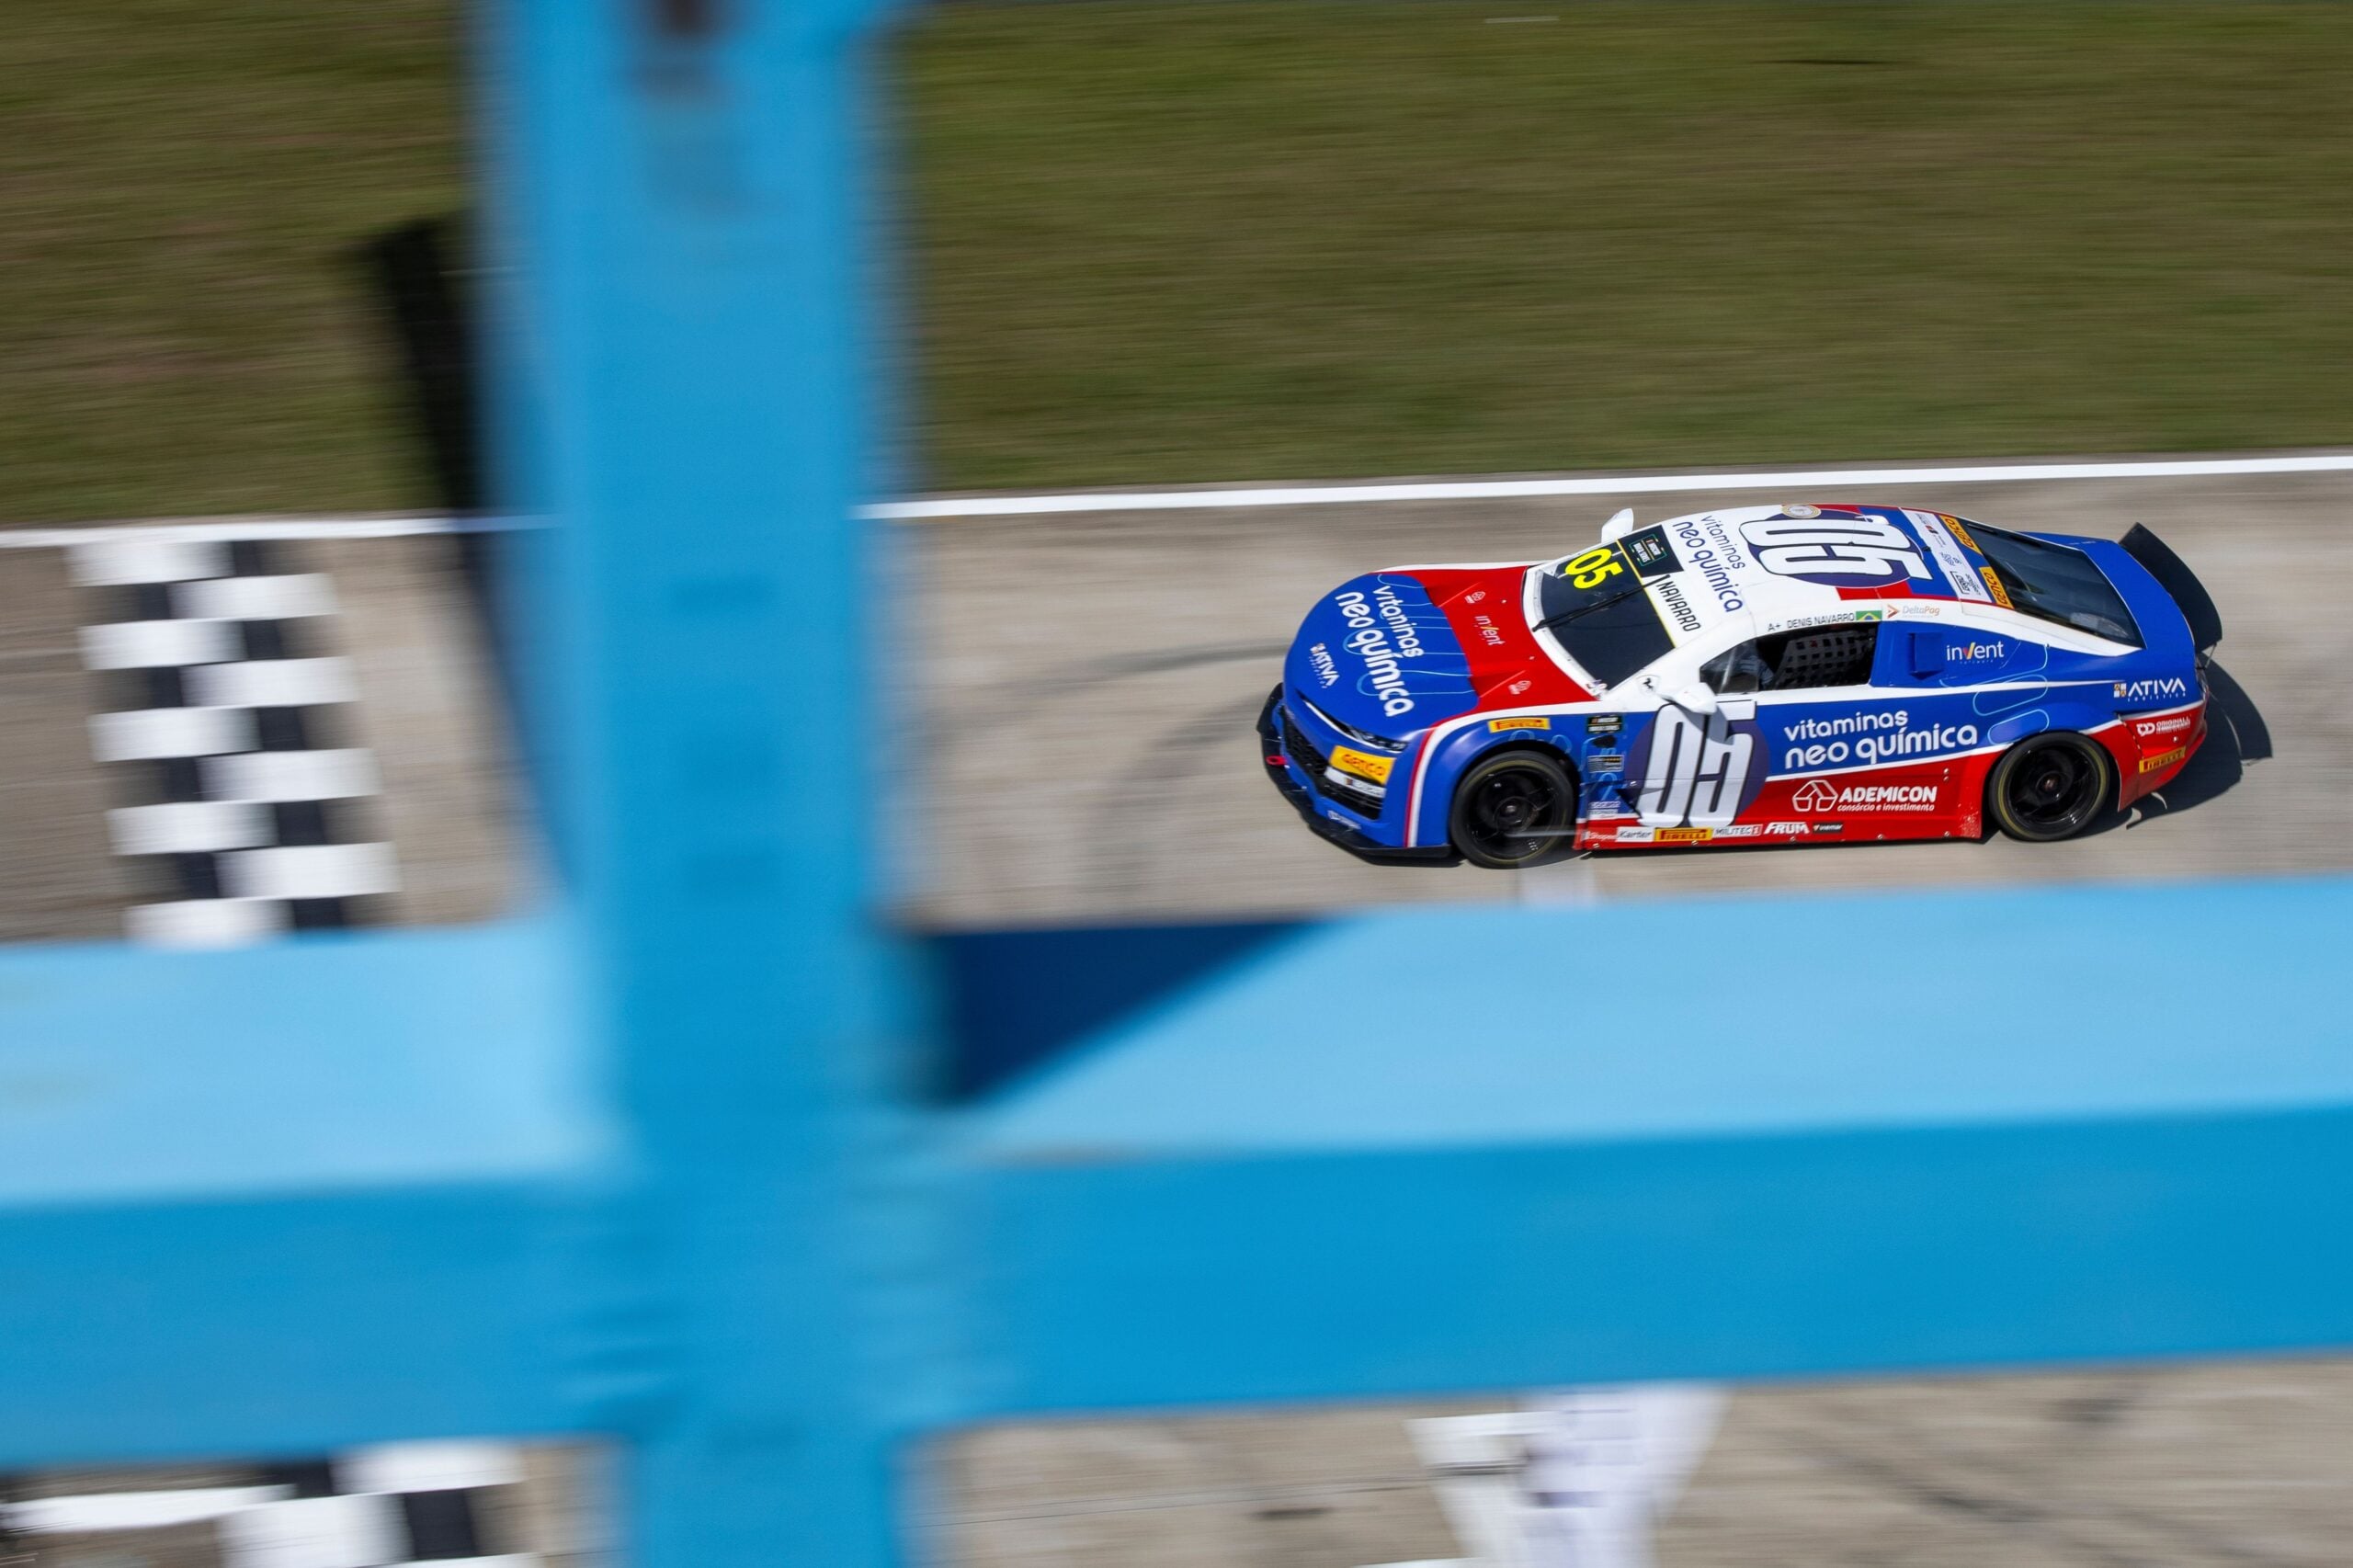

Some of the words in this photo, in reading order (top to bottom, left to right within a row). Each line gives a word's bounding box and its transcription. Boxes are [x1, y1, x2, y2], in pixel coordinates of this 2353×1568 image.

[1701, 515, 1745, 569] vitaminas
[1739, 518, 1933, 581] 05
[1564, 548, 1623, 589] 05
[1673, 520, 1706, 549] neo
[1694, 542, 1744, 612] química
[1336, 591, 1375, 629] neo
[1373, 585, 1424, 658] vitaminas
[1658, 581, 1700, 632] NAVARRO
[1787, 617, 1813, 629] DENIS
[1814, 612, 1855, 625] NAVARRO
[1903, 605, 1940, 616] DeltaPag
[1946, 641, 2004, 661] invent
[1347, 629, 1415, 717] química
[2128, 677, 2186, 697] ATIVA
[1784, 710, 1908, 742] vitaminas
[1638, 699, 1757, 828] 05
[1785, 741, 1848, 769] neo
[1855, 723, 1977, 765] química
[1838, 786, 1938, 802] ADEMICON
[1882, 802, 1935, 812] investimento
[1660, 829, 1708, 840] PIRELLI
